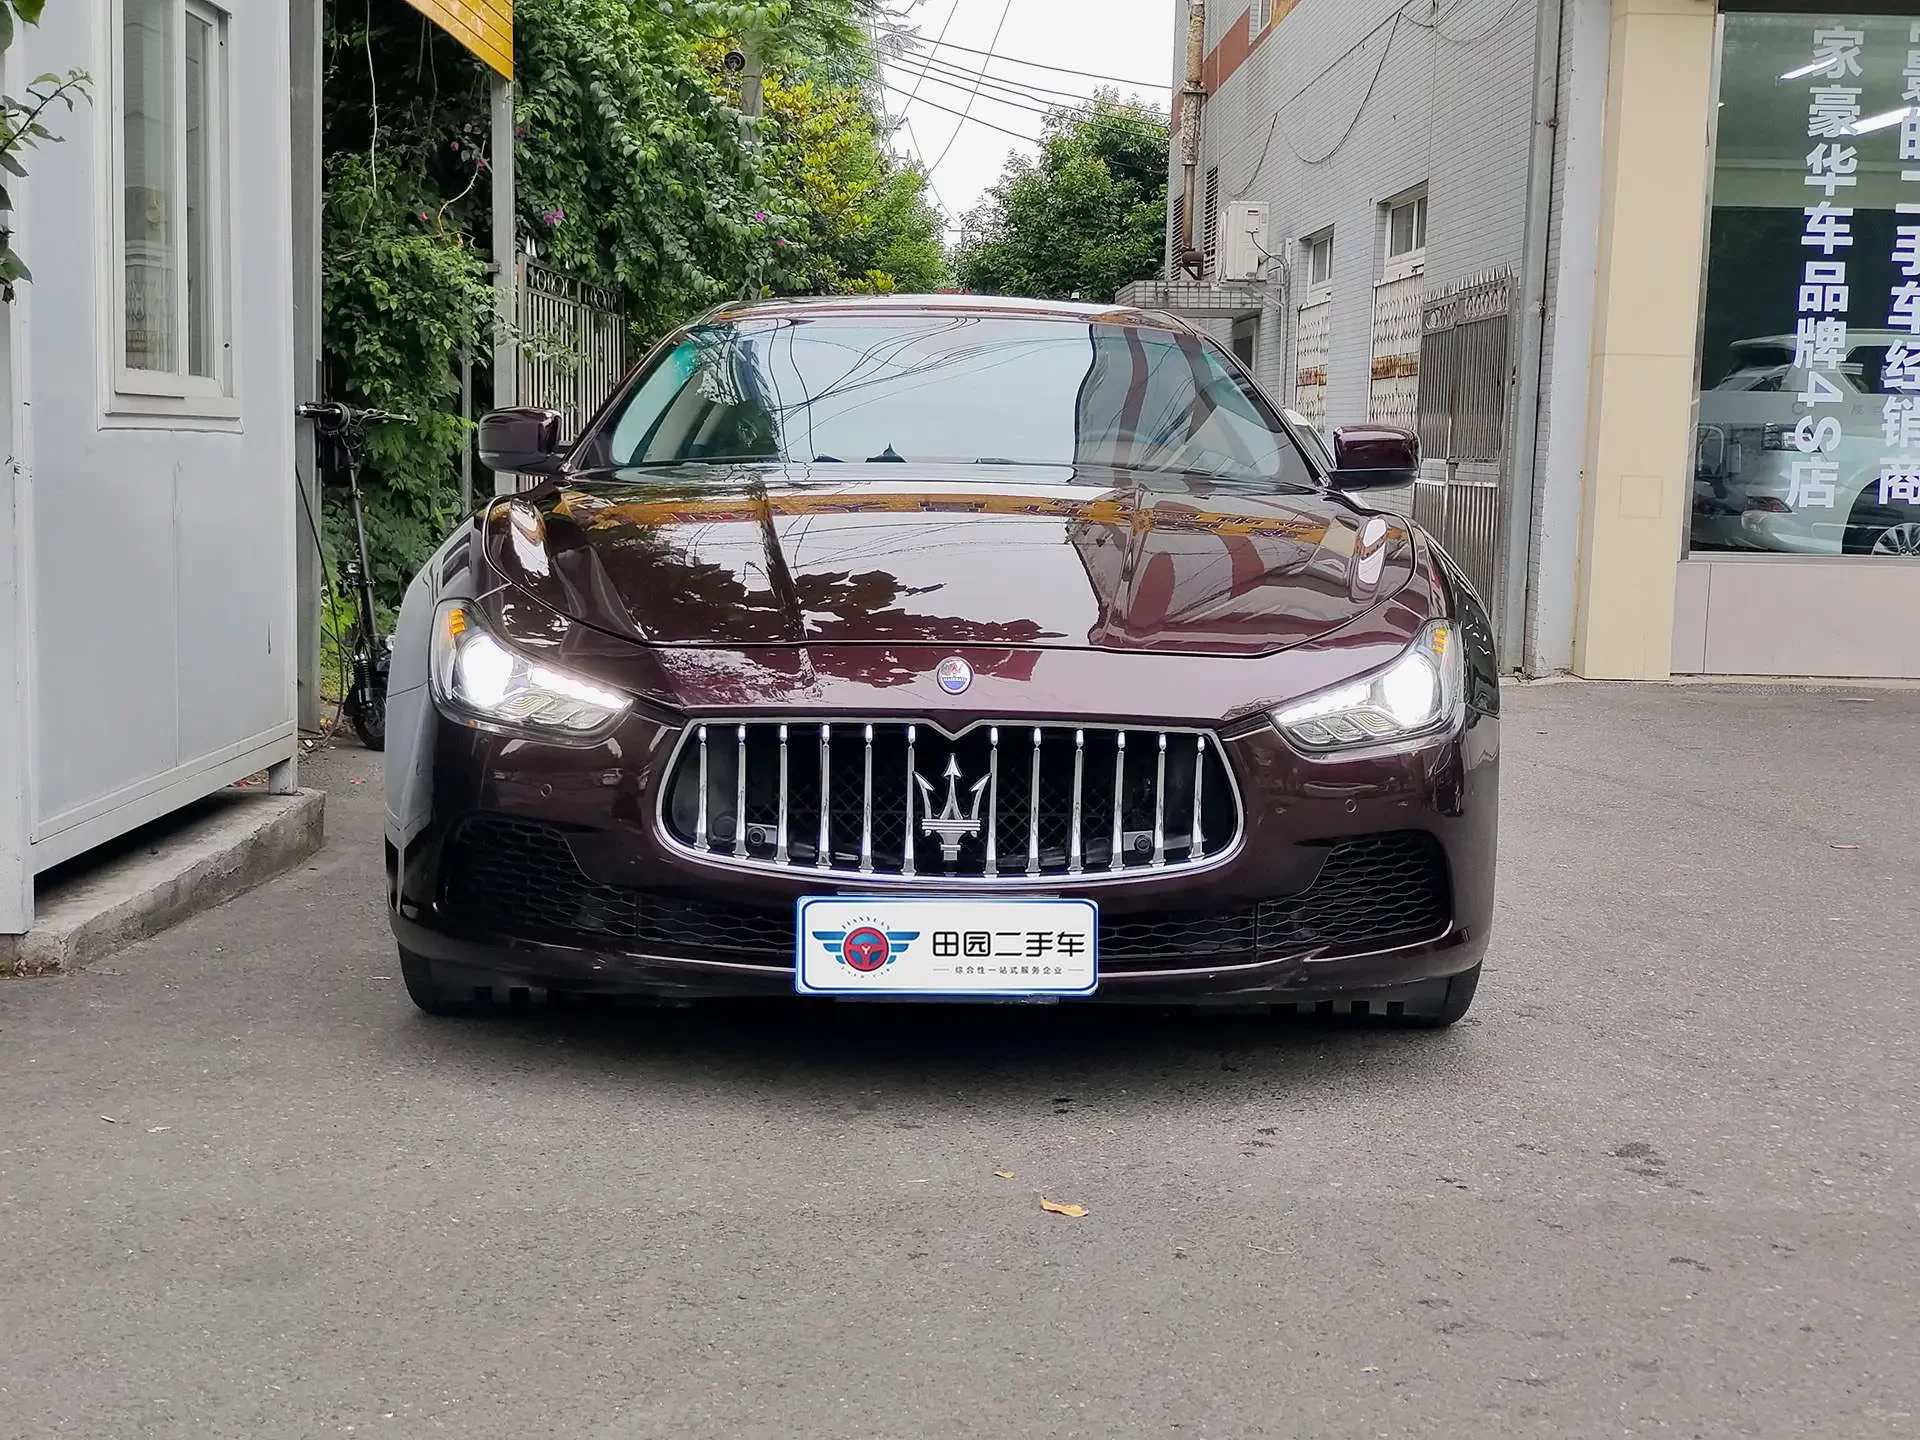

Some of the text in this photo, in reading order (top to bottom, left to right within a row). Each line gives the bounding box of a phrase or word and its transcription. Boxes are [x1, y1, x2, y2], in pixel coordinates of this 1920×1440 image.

[1785, 26, 1865, 508] 家豪华车品牌4S店
[1879, 22, 1920, 504] 手车经销商
[932, 931, 1085, 957] 田园二手车
[955, 965, 1062, 975] 综合性一站式服务企业
